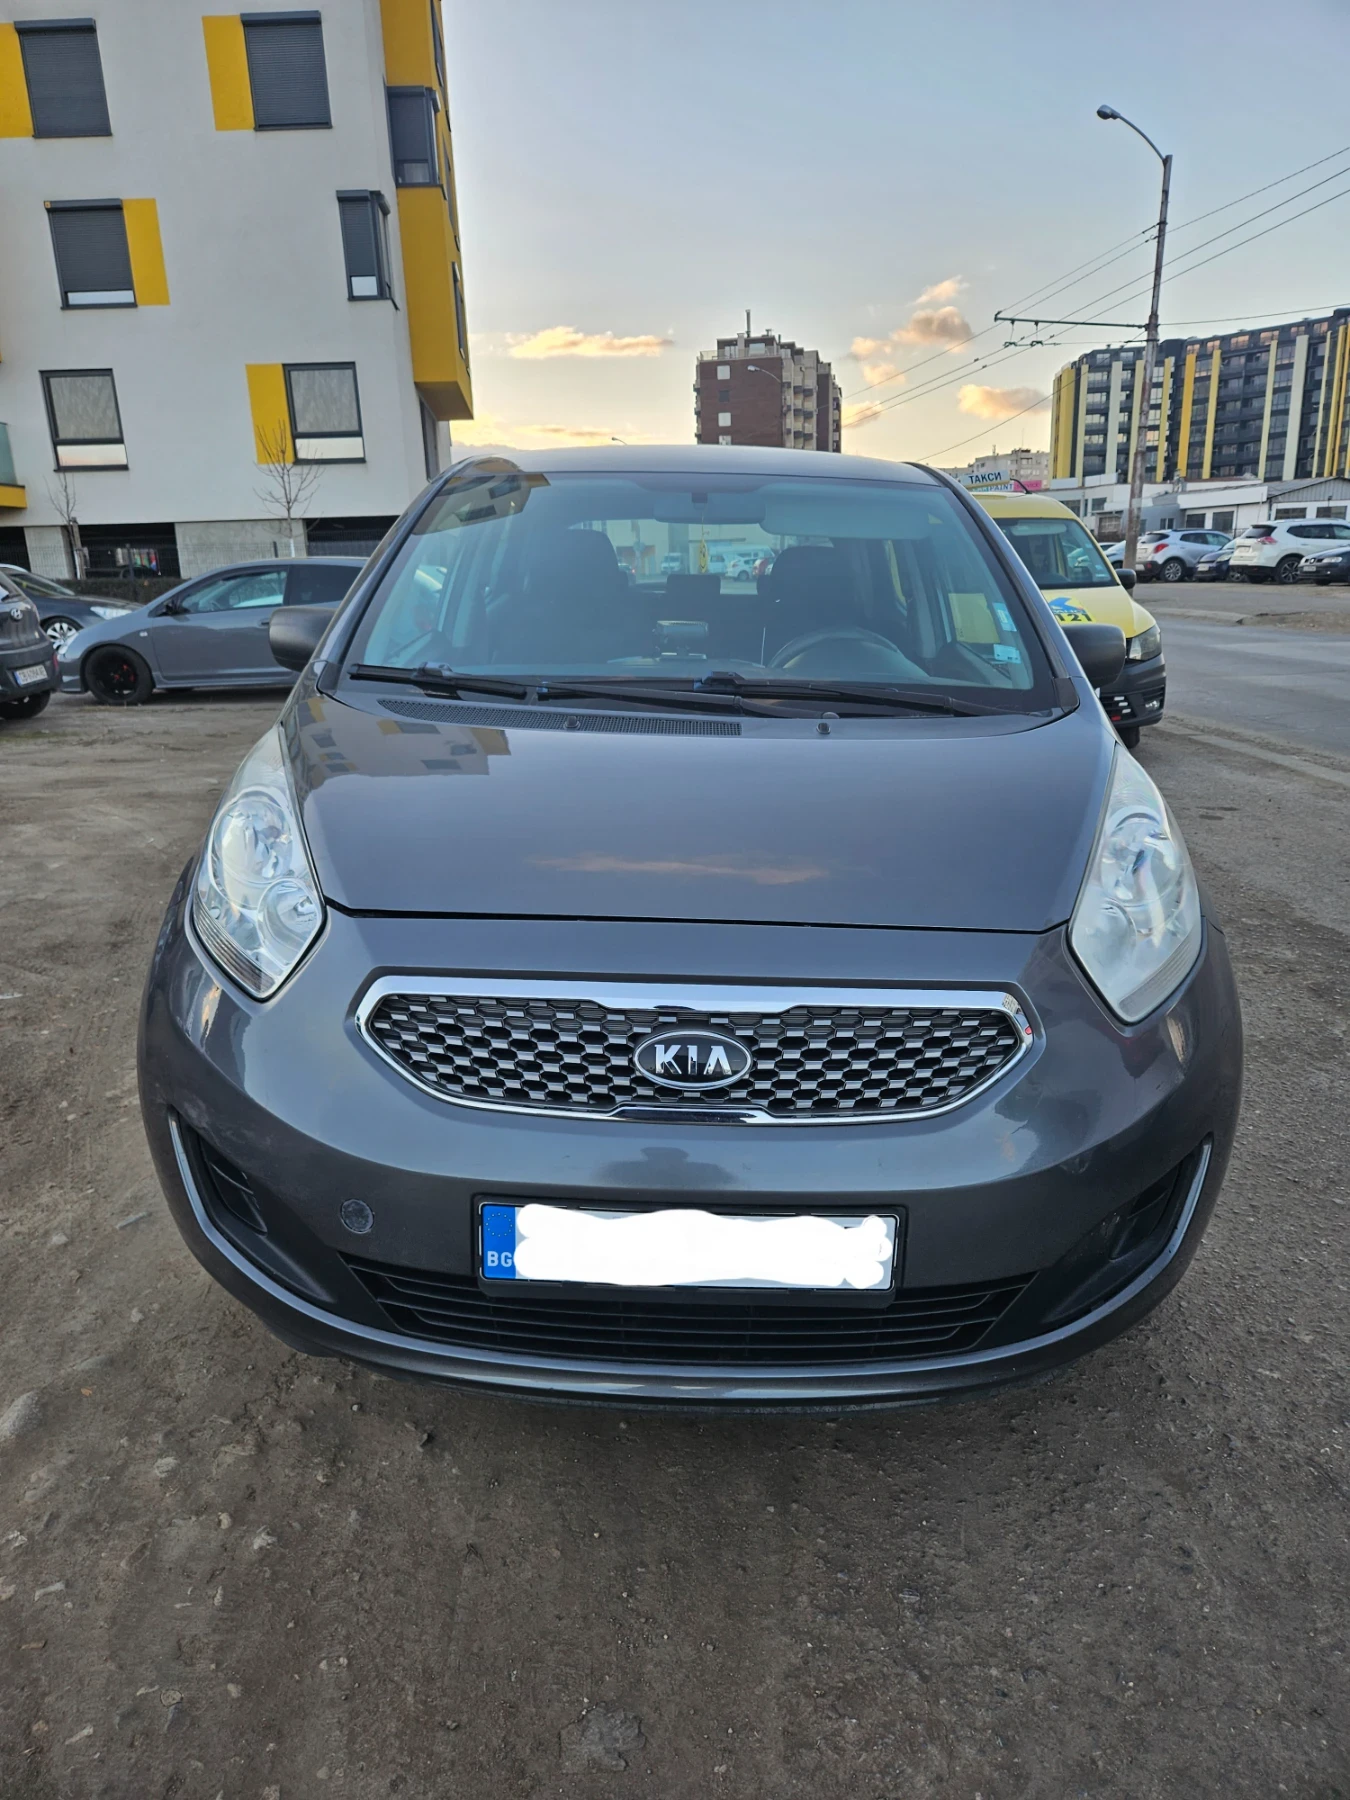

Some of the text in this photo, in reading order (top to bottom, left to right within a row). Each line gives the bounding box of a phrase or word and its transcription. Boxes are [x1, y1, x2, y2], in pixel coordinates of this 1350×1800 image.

[969, 472, 1002, 484] ТАКСИ
[654, 1044, 732, 1075] KIA
[487, 1251, 512, 1267] BG
